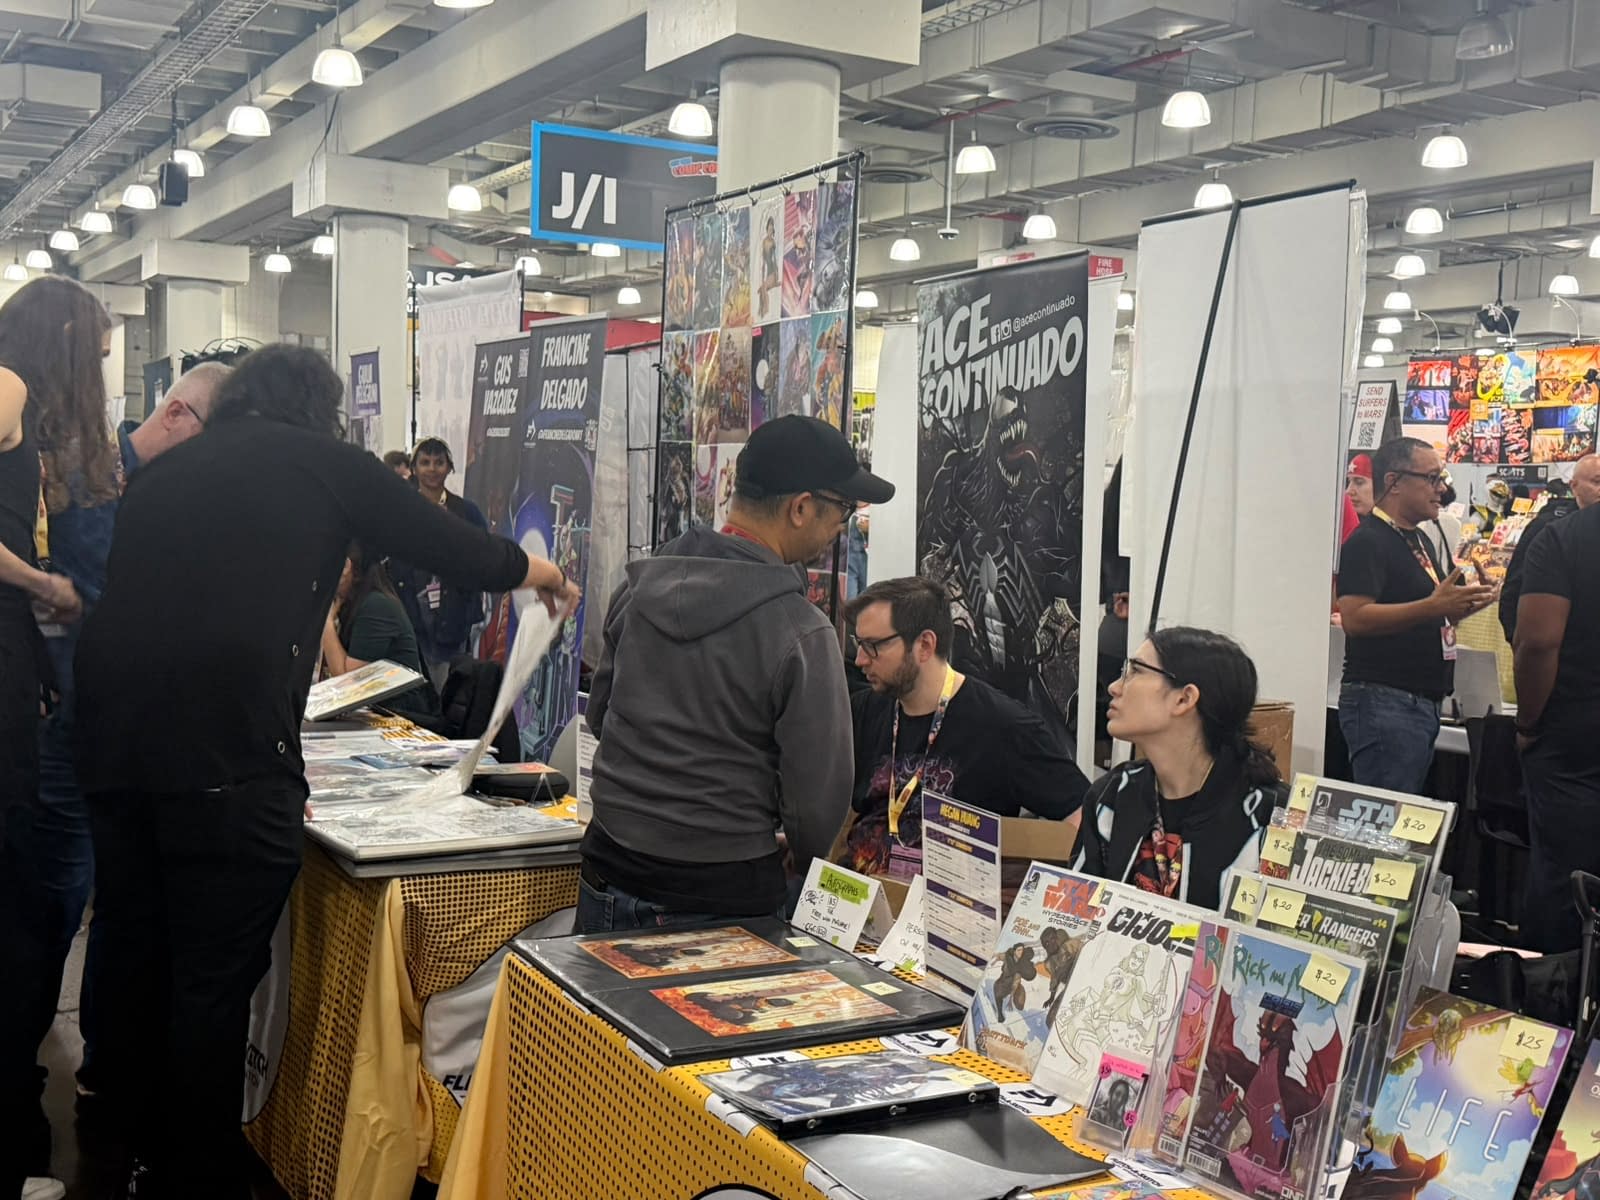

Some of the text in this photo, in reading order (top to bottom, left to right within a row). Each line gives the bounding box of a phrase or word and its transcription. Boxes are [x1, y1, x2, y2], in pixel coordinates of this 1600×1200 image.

[551, 171, 617, 230] J/I
[1097, 258, 1113, 267] FIRE
[1013, 294, 1076, 333] @acecontinuado
[921, 293, 992, 378] ACE
[541, 333, 591, 369] FRANCINE
[494, 354, 513, 386] GUS
[921, 315, 1084, 429] CONTINUADO
[483, 387, 519, 416] VAZQUEZ
[540, 377, 589, 411] DELGADO
[1366, 386, 1384, 396] SEND
[1339, 798, 1396, 829] STA
[1402, 817, 1426, 831] $20
[1374, 871, 1397, 886] $20
[1042, 910, 1089, 926] HYPERSPACE
[1272, 898, 1292, 911] $20
[1047, 917, 1079, 930] STORIES
[1318, 916, 1380, 948] RANGERS
[1315, 969, 1337, 986] $20
[1515, 1030, 1545, 1050] $25
[1396, 1077, 1513, 1161] LIFE
